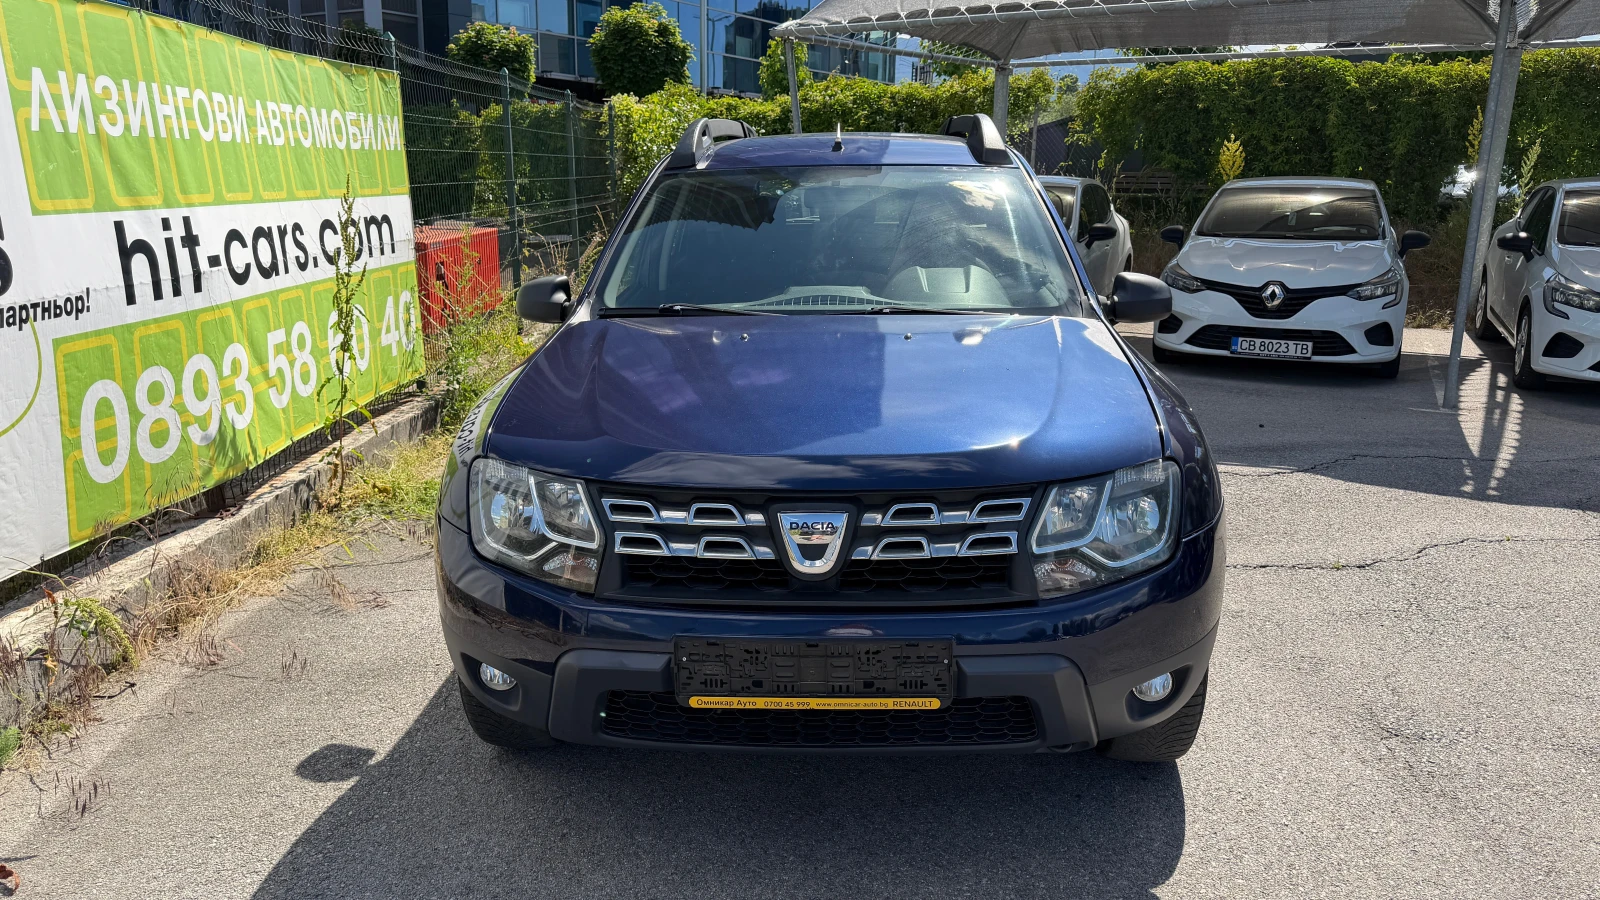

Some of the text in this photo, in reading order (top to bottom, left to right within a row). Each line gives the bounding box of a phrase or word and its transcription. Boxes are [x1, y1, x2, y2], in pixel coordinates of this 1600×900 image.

[31, 66, 401, 151] ЛИЗИНГОВИ АВТОМОБИЛИ
[113, 213, 396, 306] hit-cars.com
[1240, 339, 1309, 355] CB 8023 TB
[80, 341, 254, 484] 0893
[267, 321, 317, 409] 58
[382, 290, 416, 357] 40
[789, 521, 836, 531] DACIA
[696, 698, 735, 707] Омникар
[737, 699, 757, 707] Ауто
[763, 700, 783, 708] 0700
[892, 700, 934, 708] RENAULT
